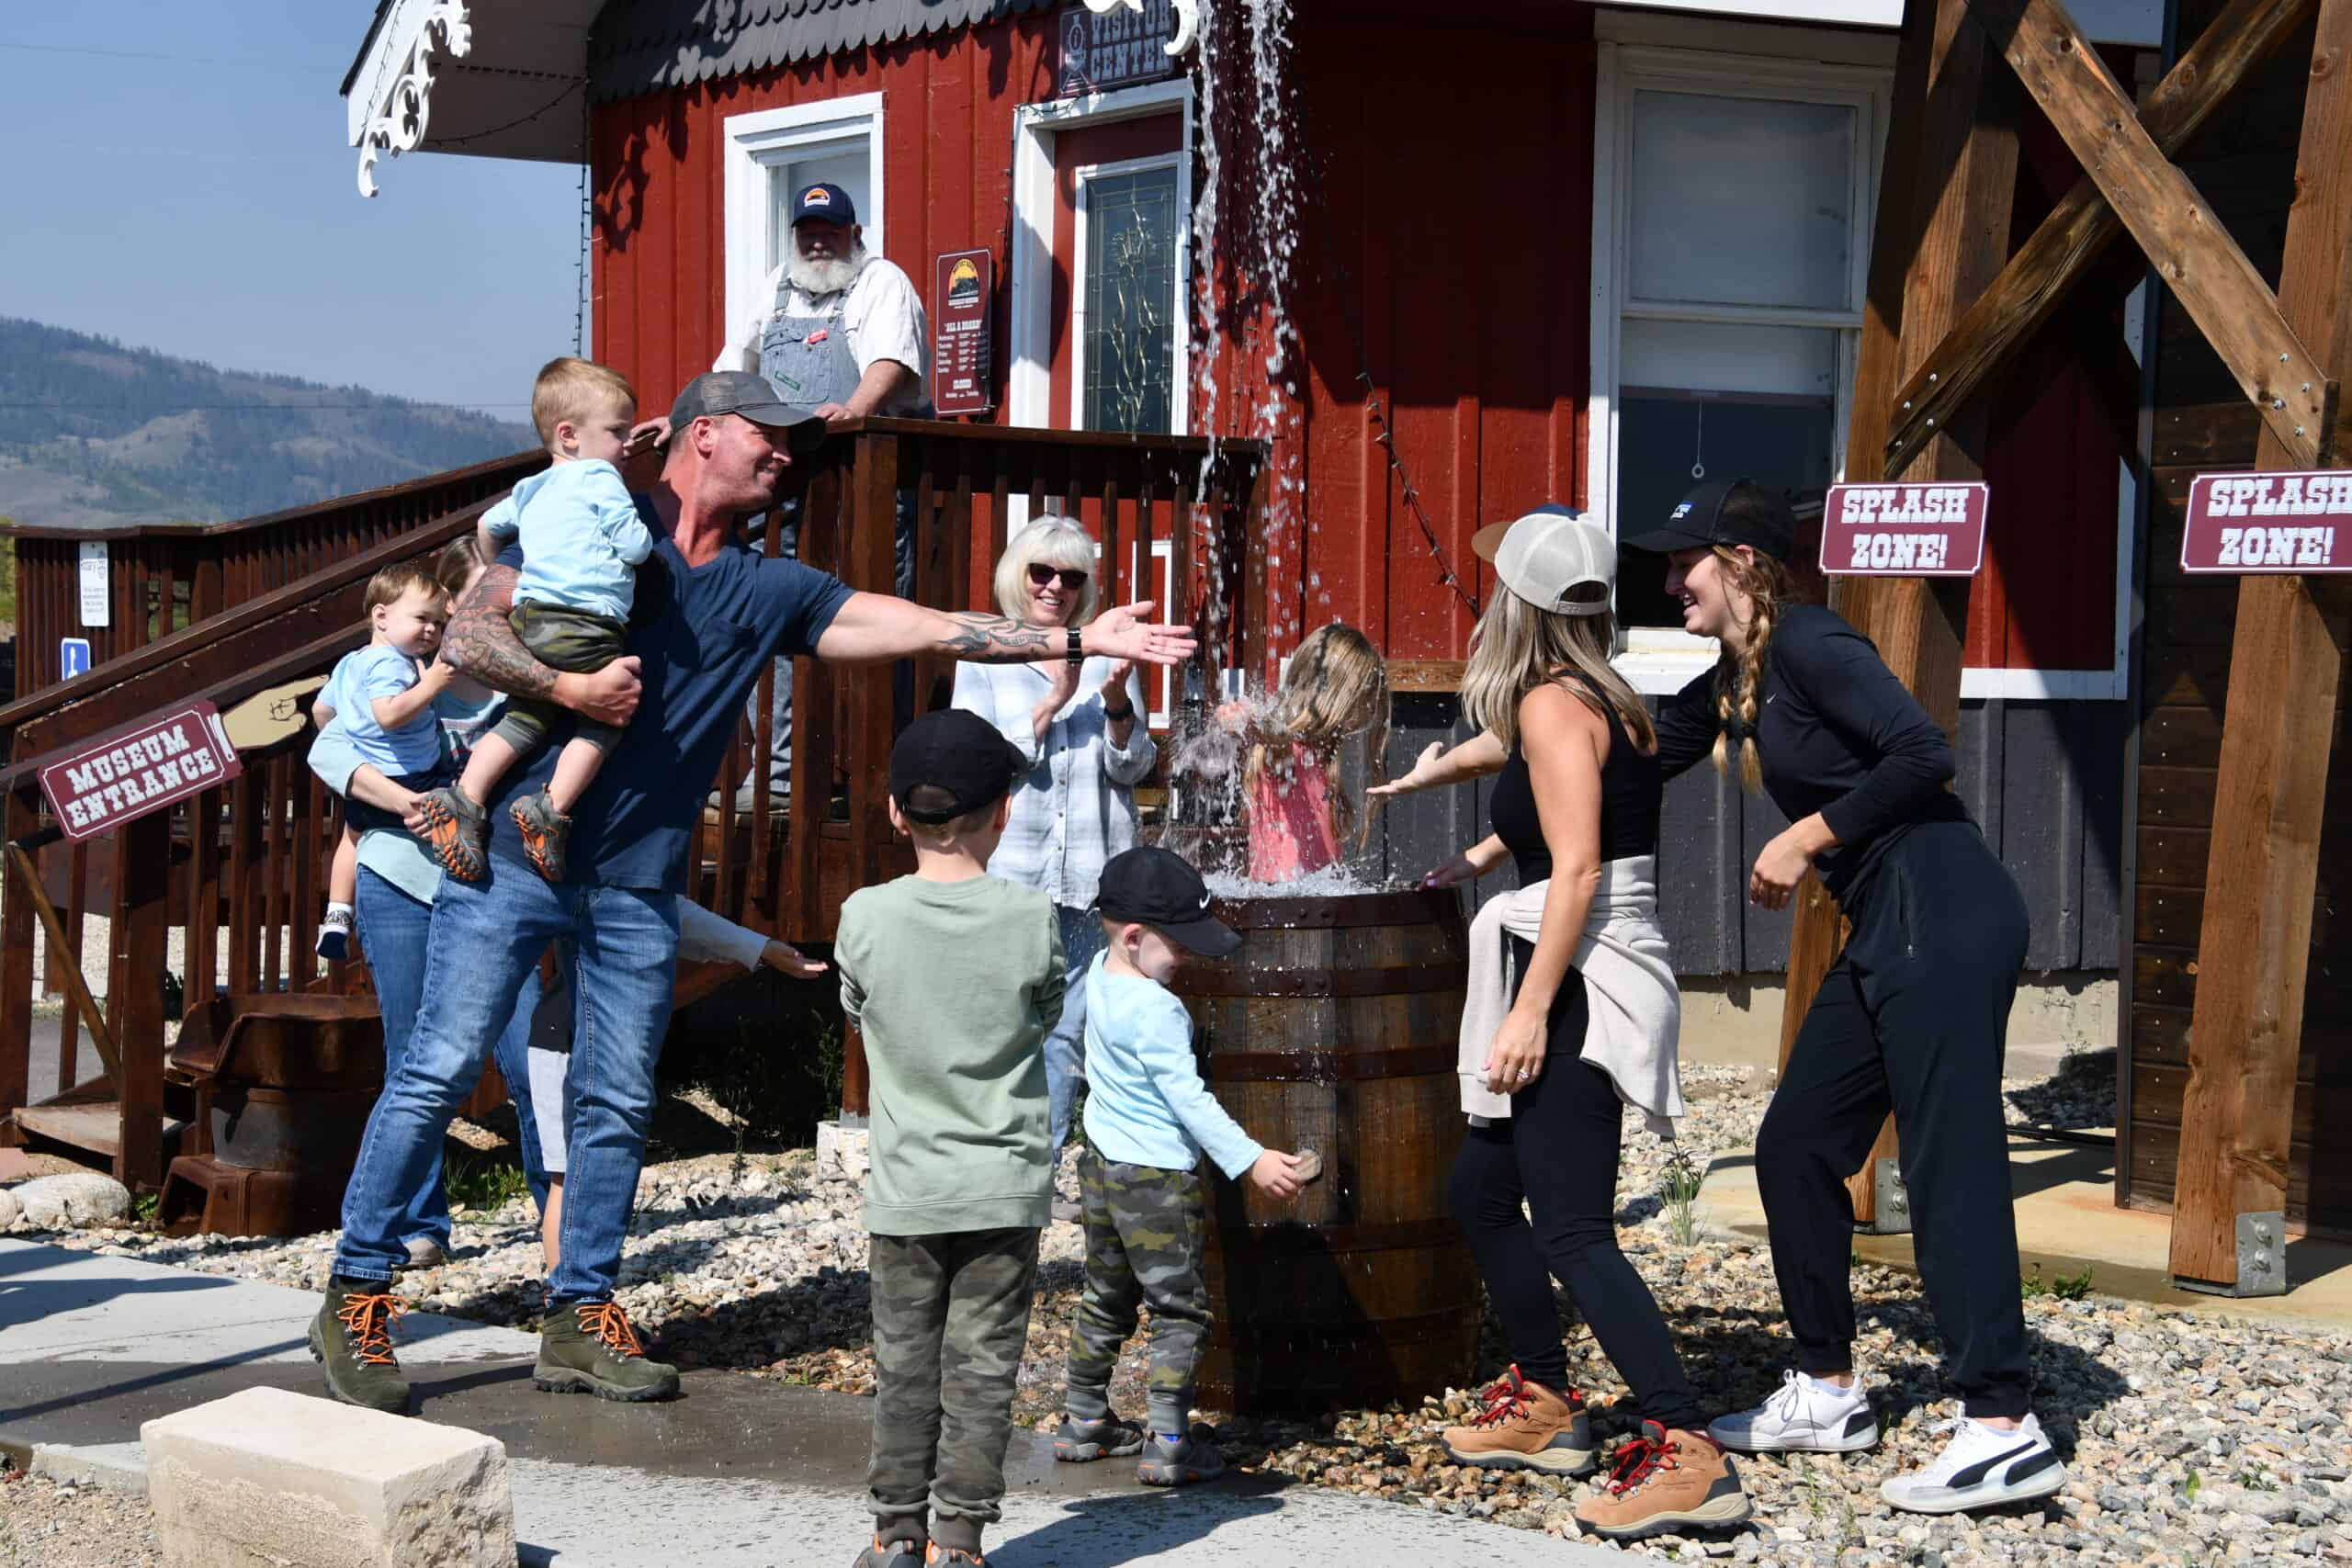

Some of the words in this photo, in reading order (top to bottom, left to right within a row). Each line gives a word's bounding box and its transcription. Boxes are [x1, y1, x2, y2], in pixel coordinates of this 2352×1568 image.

[1091, 0, 1170, 45] VISITOR
[1091, 35, 1170, 82] CENTER
[1841, 488, 1970, 524] SPLASH
[2207, 476, 2352, 517] SPLASH
[1850, 533, 1949, 570] ZONE!
[2217, 526, 2335, 566] ZONE!
[65, 724, 191, 795] MUSEUM
[65, 747, 217, 829] ENTRANCE
